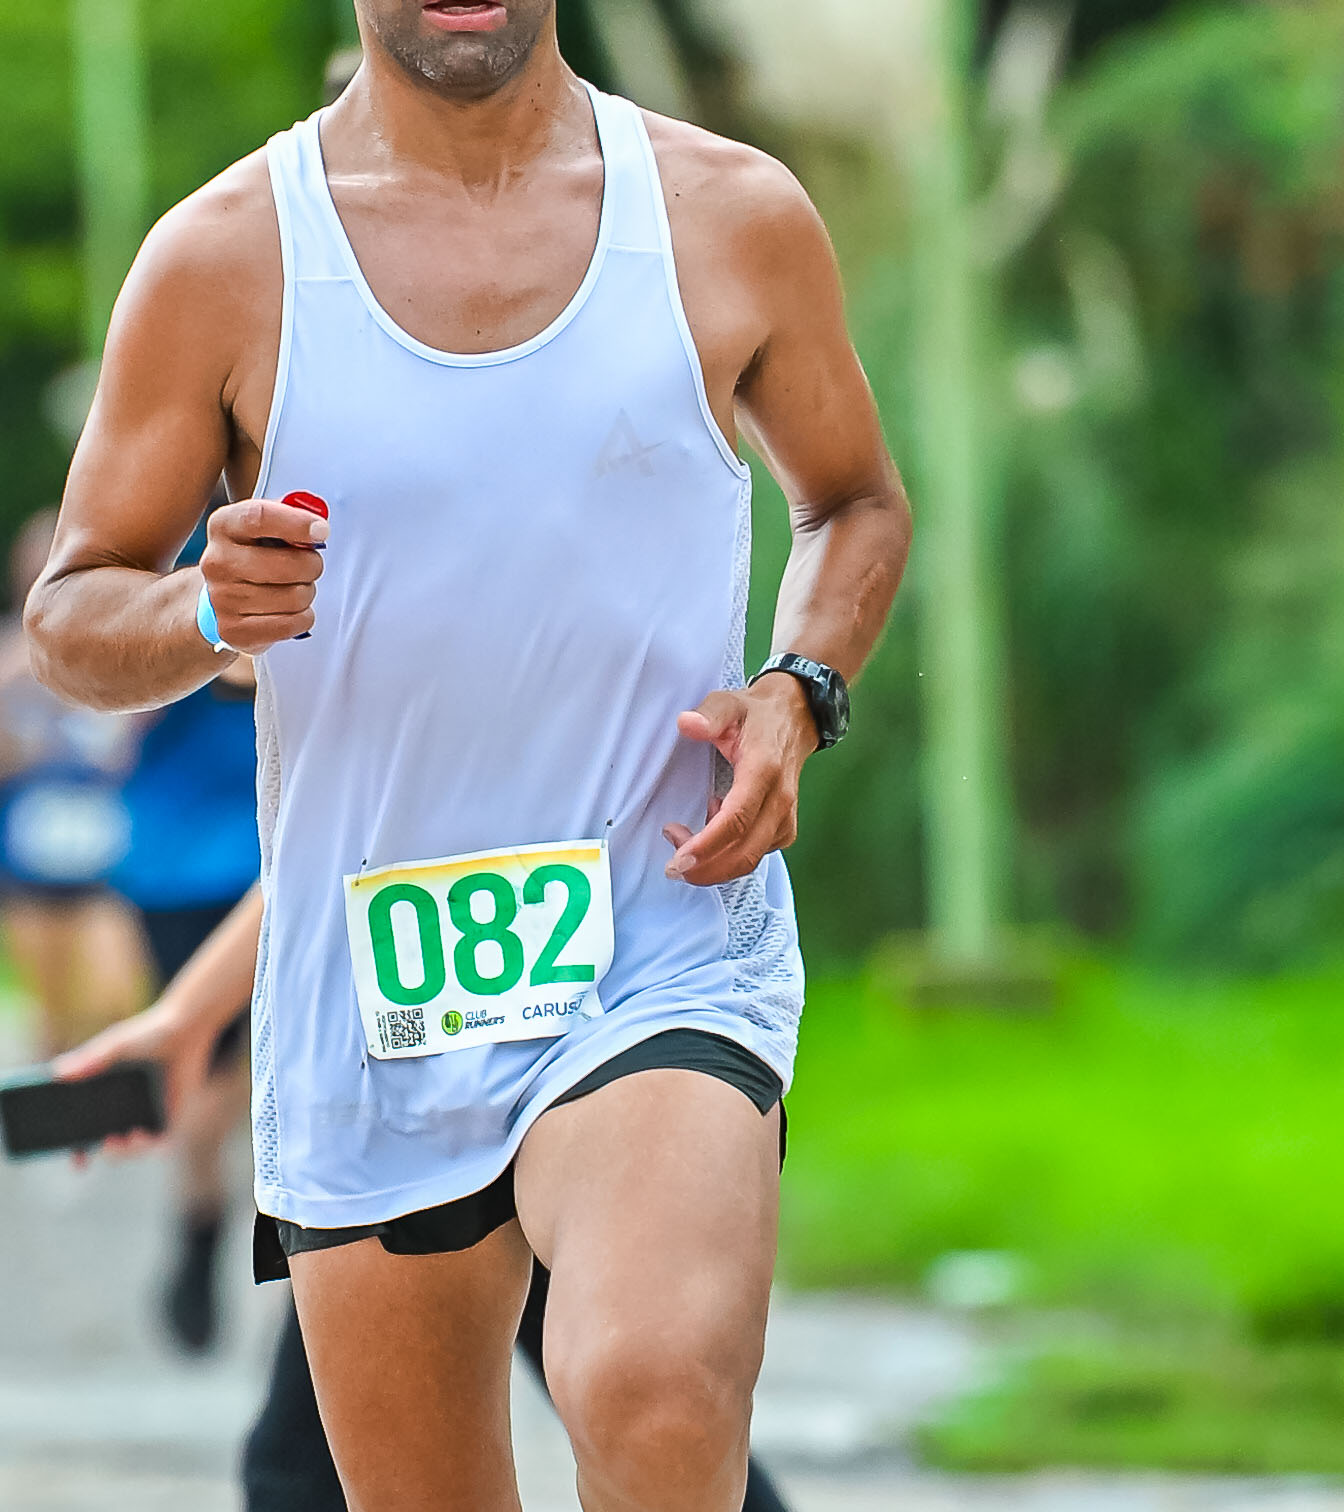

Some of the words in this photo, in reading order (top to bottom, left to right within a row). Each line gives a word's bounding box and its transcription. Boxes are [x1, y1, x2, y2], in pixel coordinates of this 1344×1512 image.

[368, 864, 595, 1005] 082
[465, 1009, 487, 1020] CLUB
[522, 996, 583, 1020] CARUS
